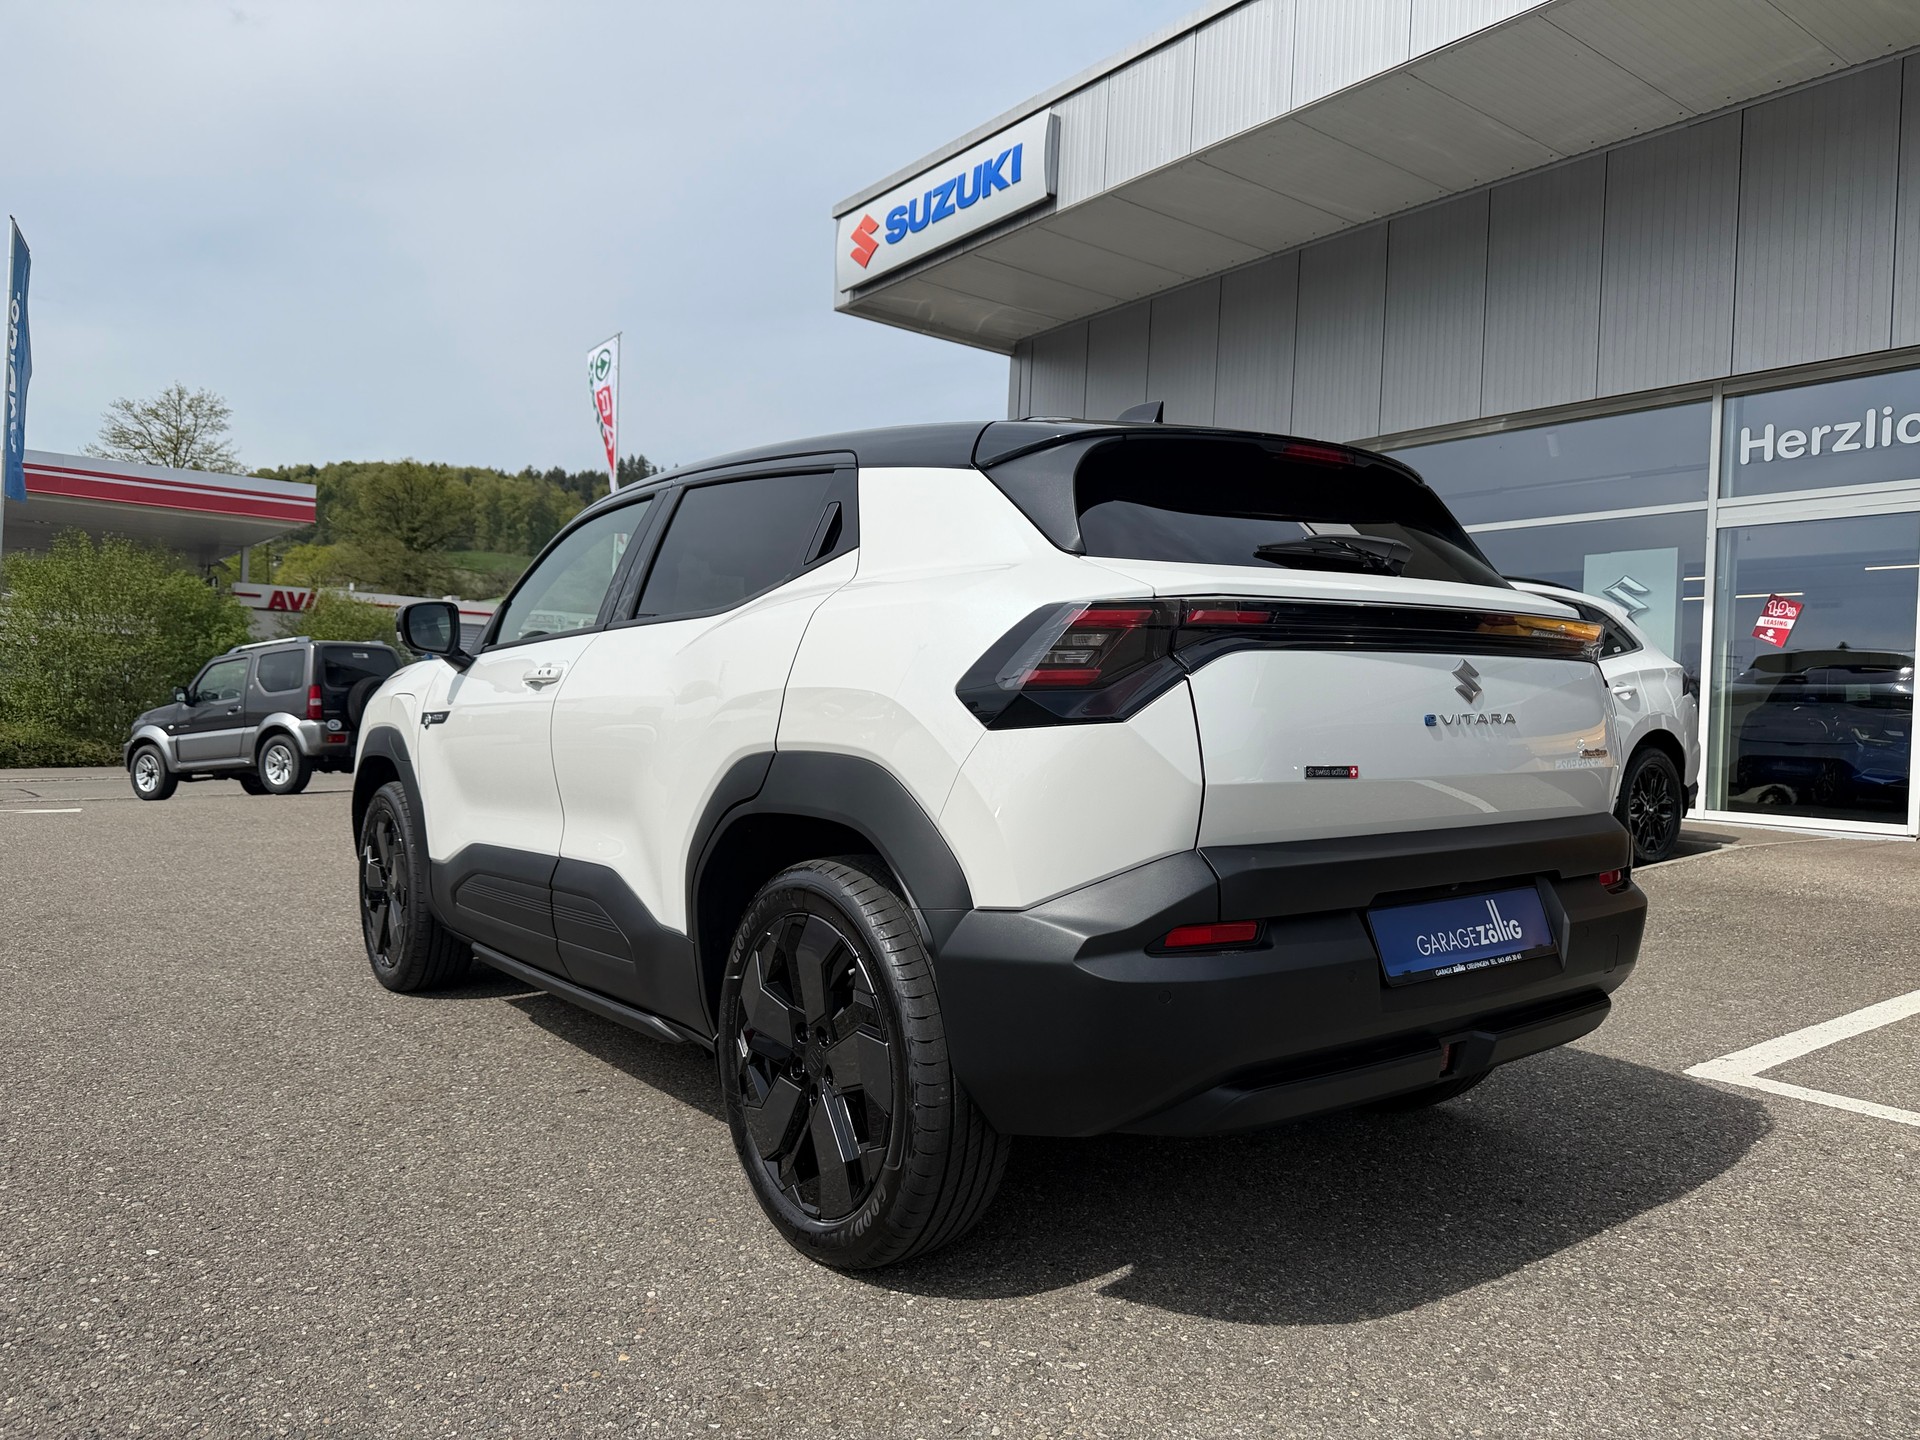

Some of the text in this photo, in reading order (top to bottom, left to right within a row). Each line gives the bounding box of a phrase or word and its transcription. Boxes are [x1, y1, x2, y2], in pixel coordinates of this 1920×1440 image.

[885, 142, 1023, 245] SUZUKI
[1763, 619, 1788, 627] LEASING
[1315, 767, 1331, 776] swiss
